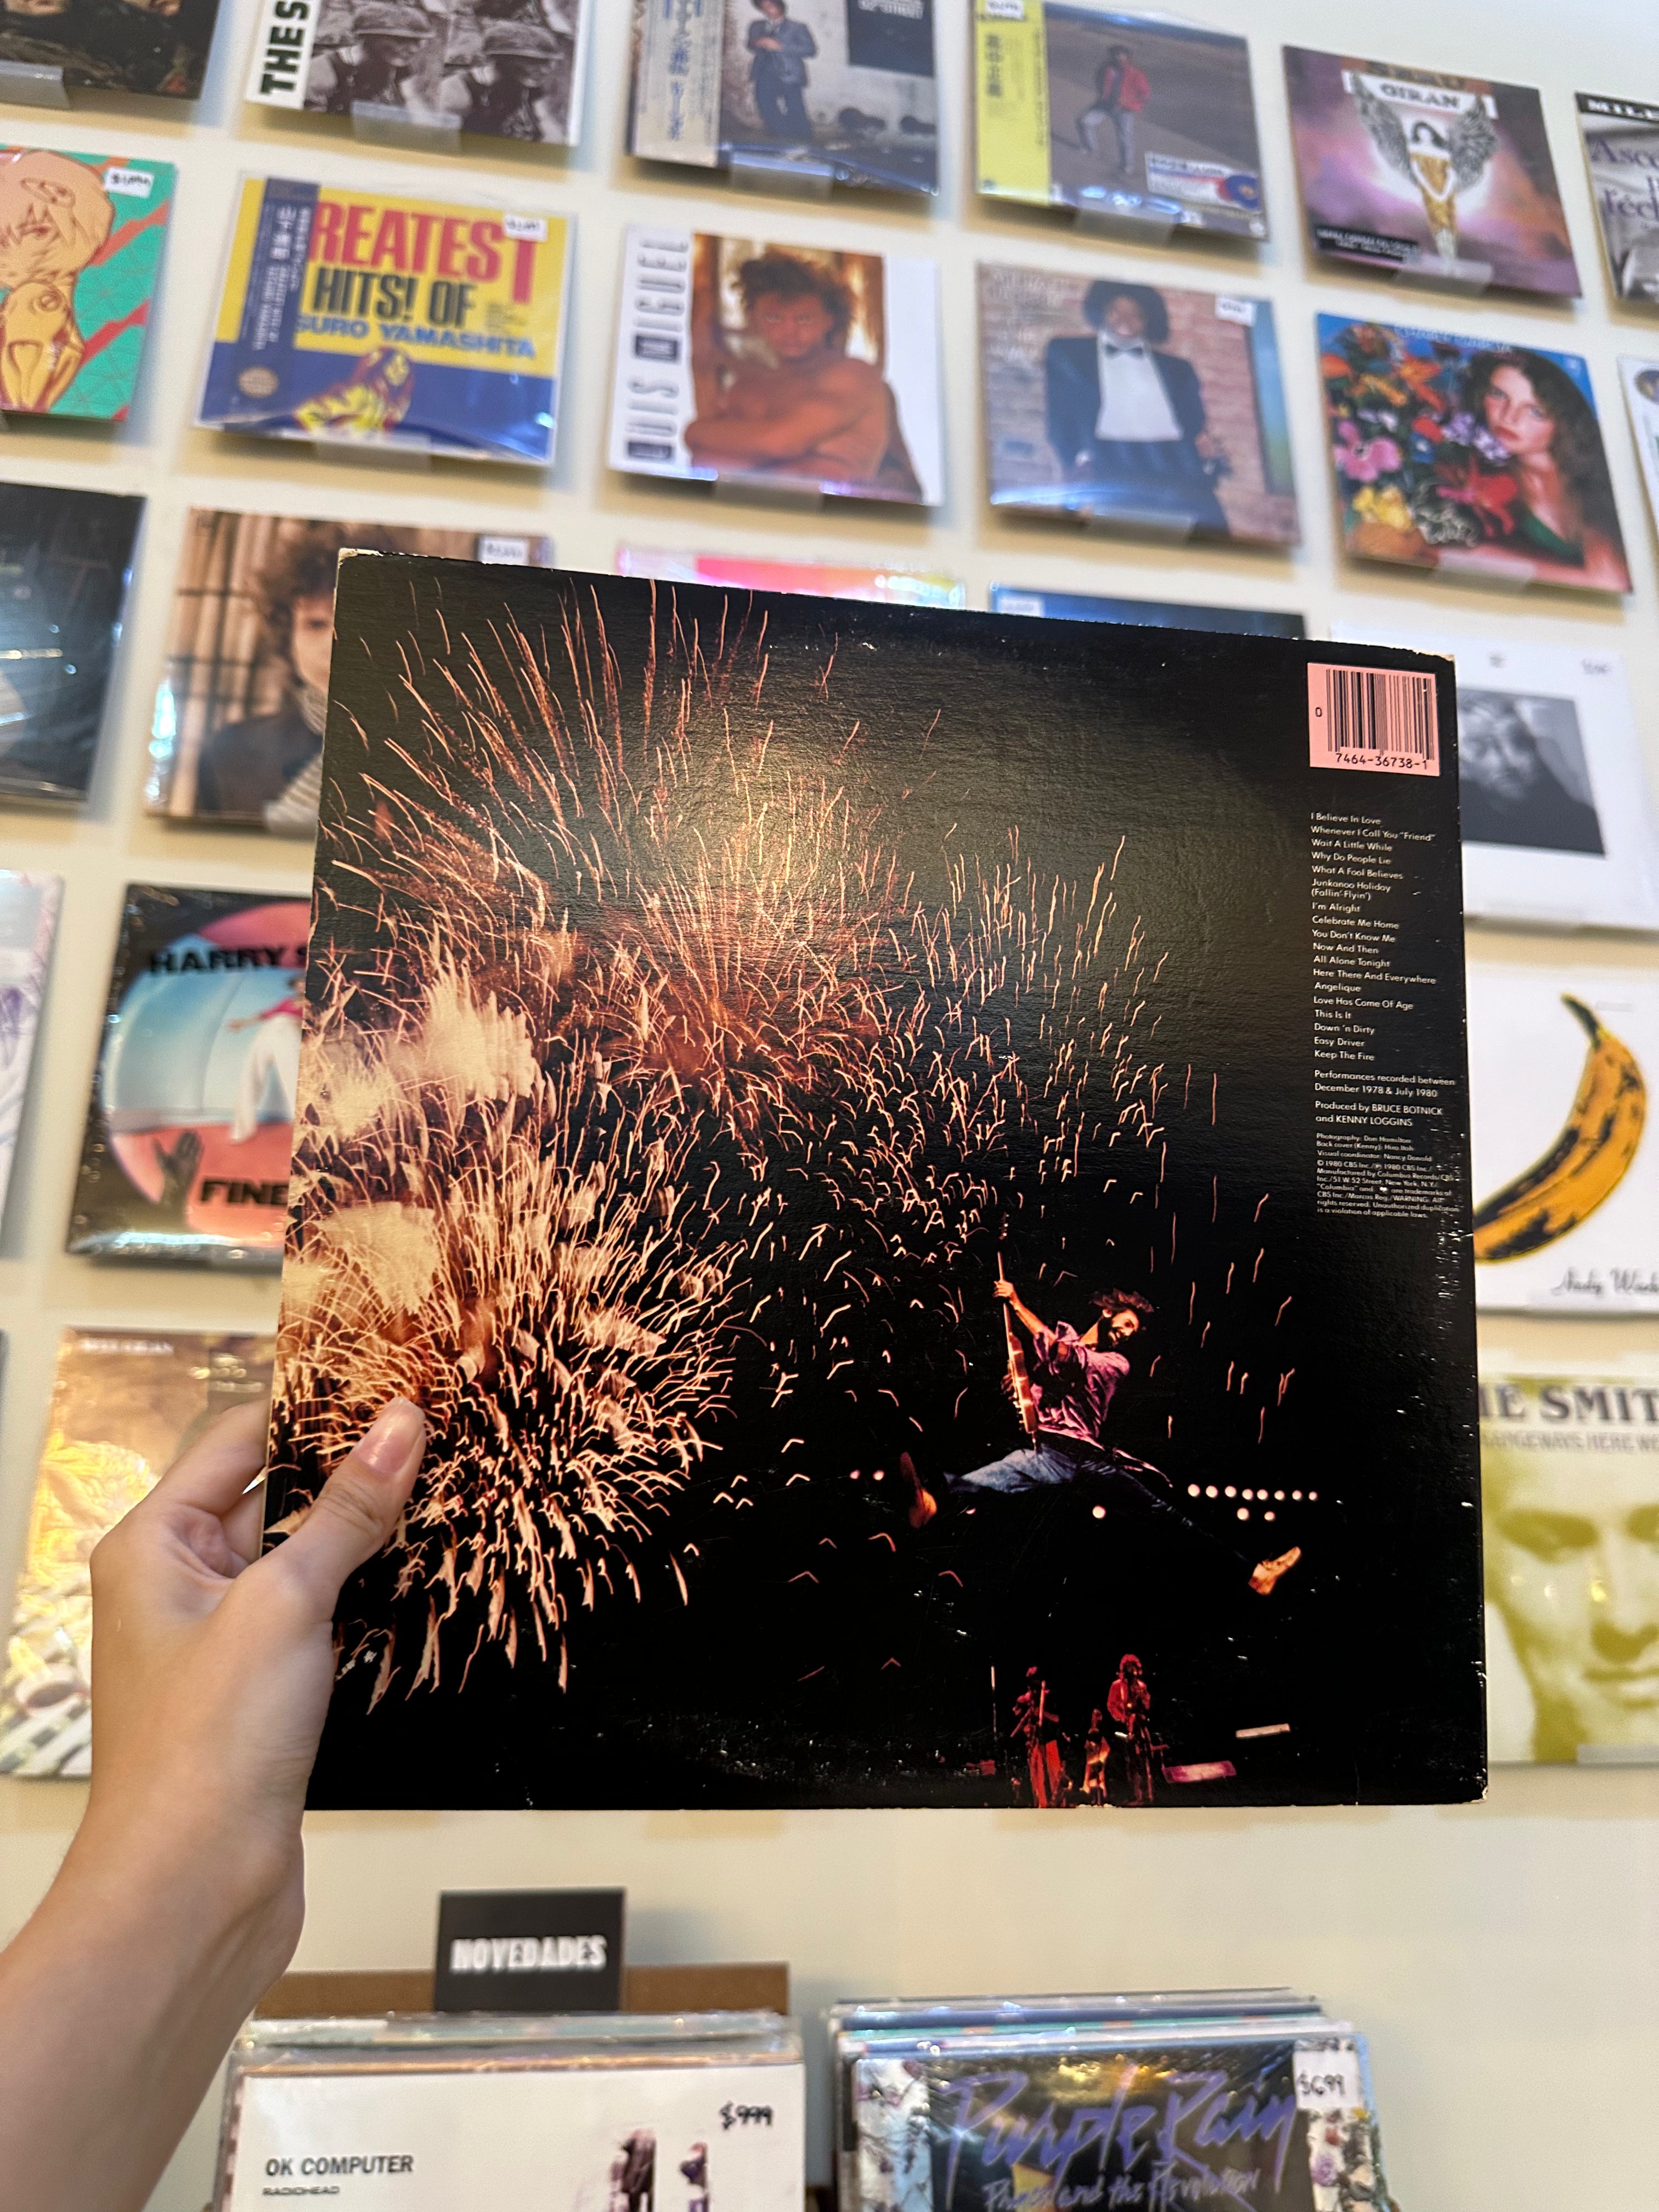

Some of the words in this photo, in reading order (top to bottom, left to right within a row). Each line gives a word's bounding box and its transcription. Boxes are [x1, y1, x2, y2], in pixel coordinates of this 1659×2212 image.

[260, 25, 304, 95] THE
[309, 200, 537, 304] REATEST
[313, 266, 419, 321] HITS!
[428, 279, 477, 328] OF
[380, 321, 536, 360] YAMASHITA
[1335, 752, 1427, 770] 7464-36738-1
[1316, 813, 1348, 822] Believe
[1361, 816, 1381, 825] Love
[1310, 826, 1356, 836] Whenever
[1362, 829, 1380, 837] Call
[1382, 831, 1398, 839] You
[1344, 841, 1365, 849] Little
[1367, 843, 1392, 851] While
[1311, 851, 1332, 861] Why
[1347, 854, 1376, 865] People
[1379, 856, 1392, 865] Lie
[1312, 865, 1335, 874] What
[1347, 867, 1364, 876] Fool
[1367, 870, 1403, 879] Believes
[1312, 878, 1355, 889] Junkanoo
[1357, 882, 1391, 893] Holiday
[1312, 902, 1326, 910] I'm
[1329, 903, 1361, 913] Alright
[1312, 915, 1355, 926] Celebrate
[1357, 919, 1372, 927] Me
[1373, 920, 1400, 929] Home
[1312, 929, 1328, 938] You
[1330, 930, 1353, 939] Don't
[1355, 933, 1380, 941] Know
[1381, 935, 1396, 943] Me
[1313, 943, 1334, 951] Now
[1336, 944, 1355, 953] And
[1357, 945, 1379, 953] Then
[150, 947, 286, 974] HARRY
[1313, 955, 1327, 963] All
[1329, 956, 1356, 966] Alone
[1358, 958, 1391, 969] Tonight
[1313, 968, 1335, 977] Here
[1337, 970, 1362, 979] There
[1364, 972, 1383, 980] And
[1385, 973, 1436, 985] Everywhere
[1314, 982, 1361, 993] Angelique
[1313, 996, 1334, 1005] Love
[1336, 997, 1353, 1006] Has
[1355, 998, 1380, 1007] Come
[1381, 1000, 1394, 1008] Of
[1395, 1001, 1414, 1012] Age
[1314, 1009, 1333, 1018] This
[1314, 1023, 1340, 1031] Down
[1353, 1025, 1376, 1035] Dirty
[1314, 1036, 1335, 1047] Easy
[1337, 1038, 1365, 1047] Driver
[1314, 1049, 1338, 1060] Keep
[1339, 1051, 1356, 1060] The
[1357, 1052, 1375, 1061] Fire
[1314, 1070, 1375, 1081] Performances
[1377, 1075, 1415, 1084] recorded
[1418, 1076, 1456, 1086] between
[1314, 1083, 1359, 1093] December
[1362, 1085, 1383, 1094] 1978
[1385, 1086, 1392, 1094] &
[1395, 1087, 1413, 1097] July
[1416, 1088, 1438, 1097] 1980
[1315, 1101, 1356, 1111] Produced
[1358, 1103, 1370, 1113] by
[1372, 1104, 1401, 1113] BRUCE
[1403, 1106, 1443, 1115] BOTNICK
[1316, 1114, 1334, 1122] and
[1336, 1115, 1368, 1124] KENNY
[1370, 1117, 1413, 1126] LOGGINS
[1384, 1153, 1406, 1161] Nancy
[201, 1178, 291, 1207] FINE
[1539, 1384, 1659, 1423] SMIT
[449, 1934, 608, 1972] NOVEDADES
[940, 2064, 1156, 2211] Purple
[1153, 2070, 1297, 2212] Rain
[265, 2157, 294, 2176] OK
[300, 2153, 414, 2176] COMPUTER
[262, 2185, 340, 2196] RADIOHEAD
